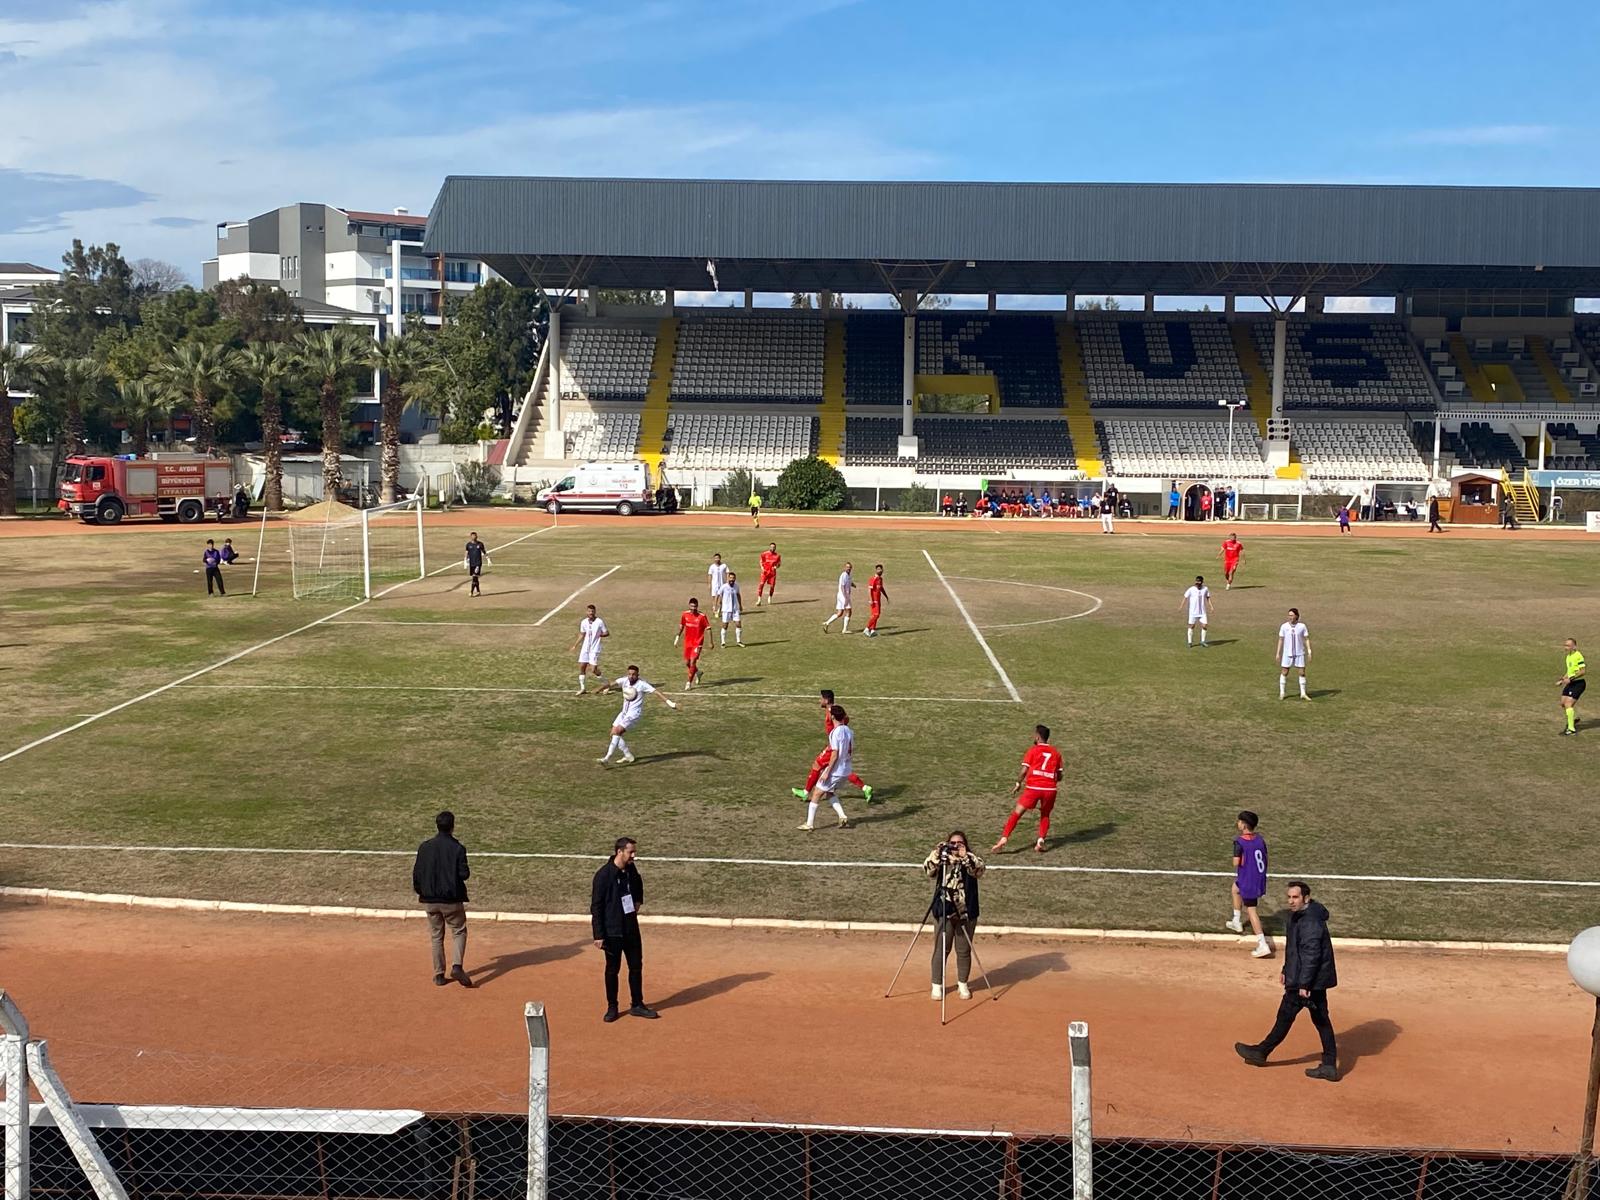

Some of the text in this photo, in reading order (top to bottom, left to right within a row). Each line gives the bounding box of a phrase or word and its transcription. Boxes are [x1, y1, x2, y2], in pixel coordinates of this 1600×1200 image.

[164, 465, 198, 473] T.C. AYDIN
[1556, 476, 1580, 486] ÖZER
[1041, 752, 1052, 771] 7
[1254, 849, 1265, 873] 8
